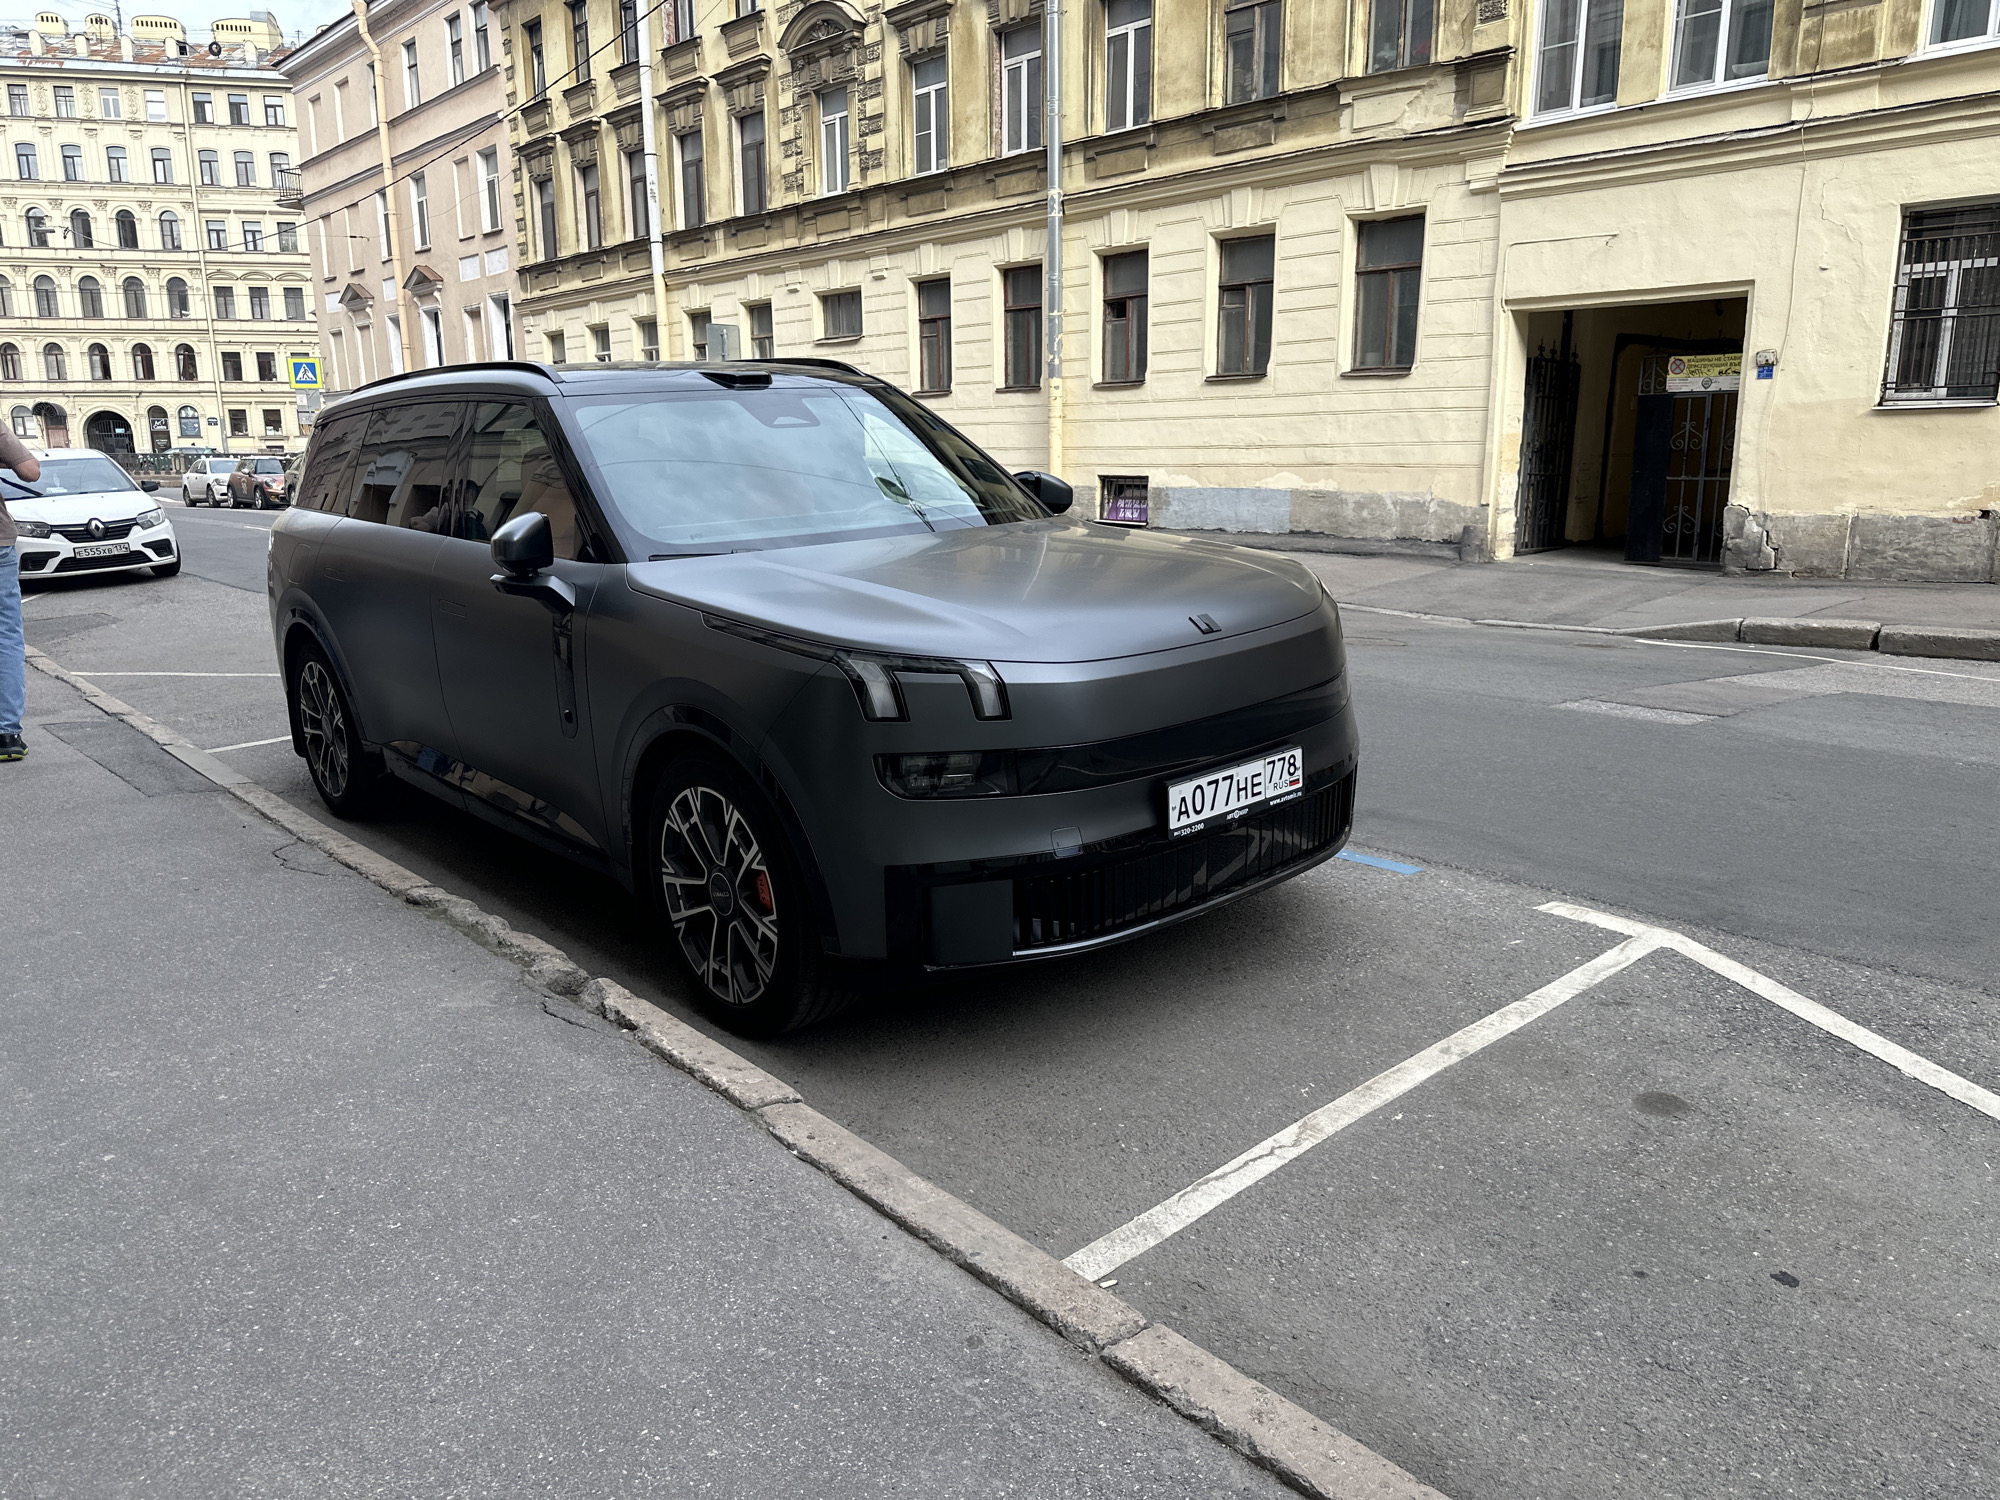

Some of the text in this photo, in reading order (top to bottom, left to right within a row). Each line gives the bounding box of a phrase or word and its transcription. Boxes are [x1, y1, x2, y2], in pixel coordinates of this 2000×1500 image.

[1177, 754, 1297, 822] А077НЕ 778
[1273, 779, 1289, 791] RUS
